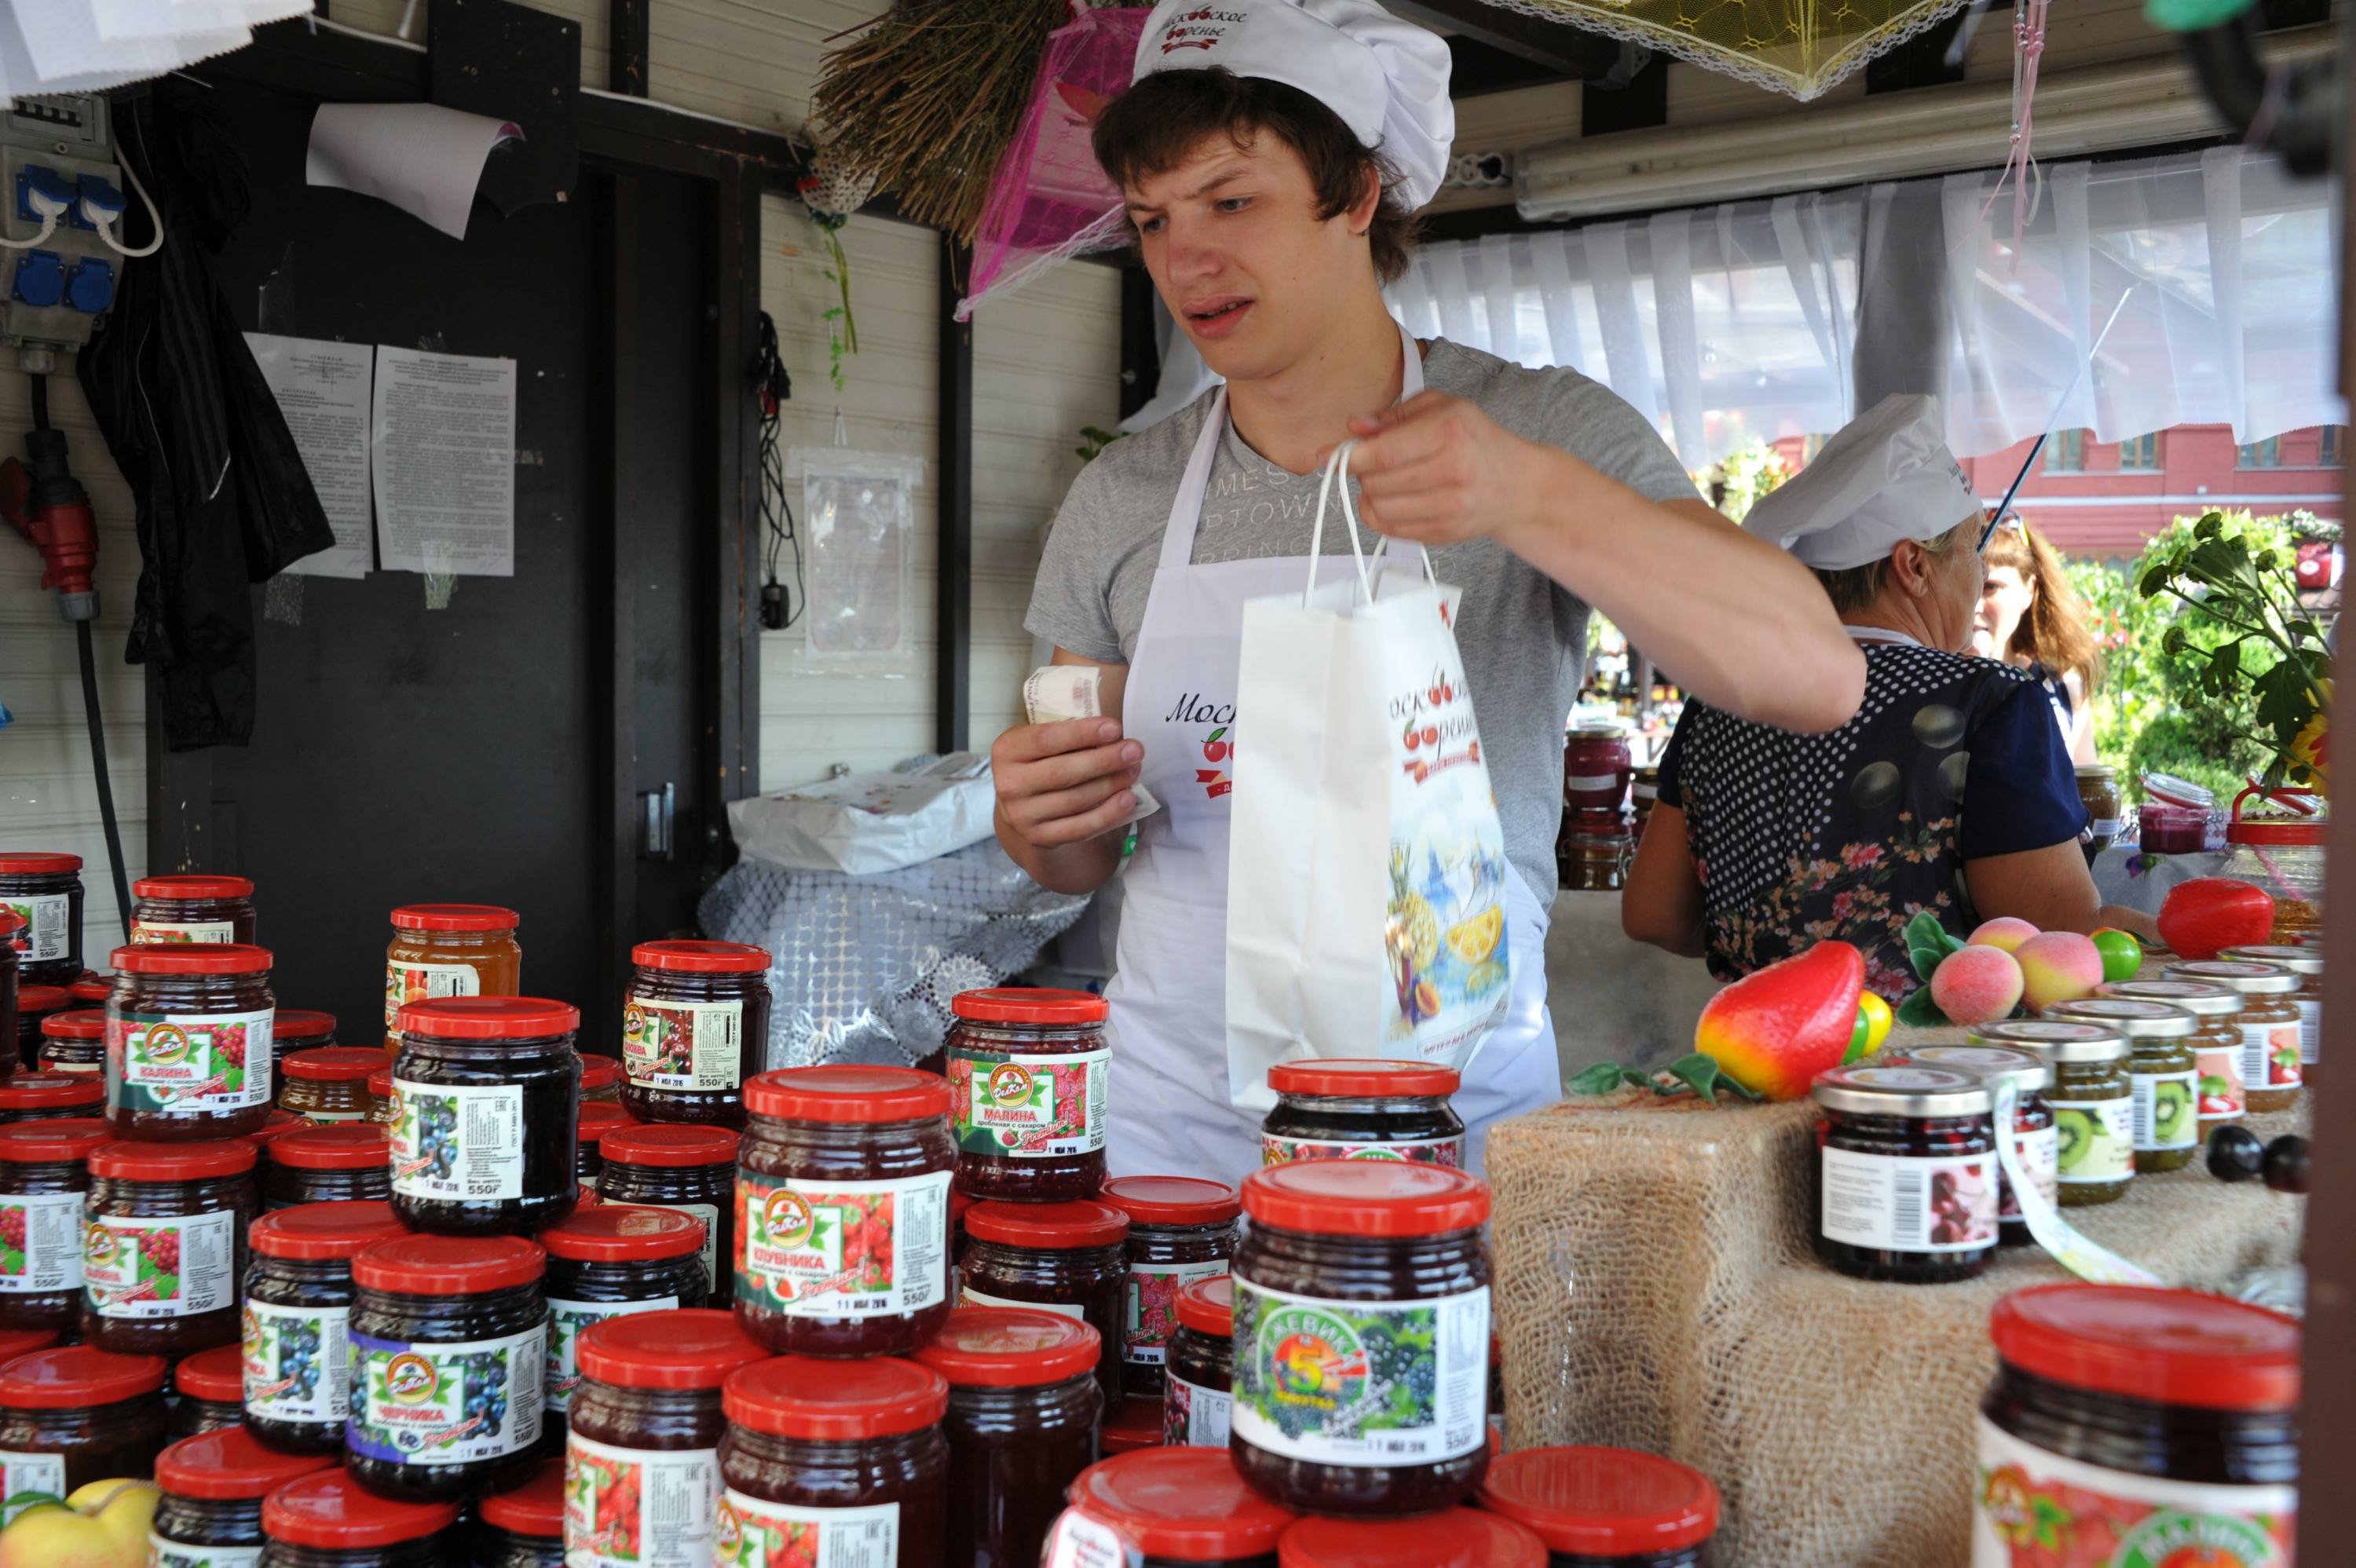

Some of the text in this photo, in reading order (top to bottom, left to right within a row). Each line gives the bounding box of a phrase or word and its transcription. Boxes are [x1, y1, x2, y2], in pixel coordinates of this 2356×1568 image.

[140, 1066, 192, 1079] КАЛИНА
[983, 1109, 1038, 1123] МАЛИНА
[1022, 1111, 1069, 1146] Premium!
[468, 1184, 499, 1195] 550г
[753, 1247, 826, 1270] КЛУБНИКА
[799, 1257, 865, 1300] Premium!
[1287, 1347, 1323, 1393] 5
[379, 1405, 445, 1421] ЧЕРНИКА
